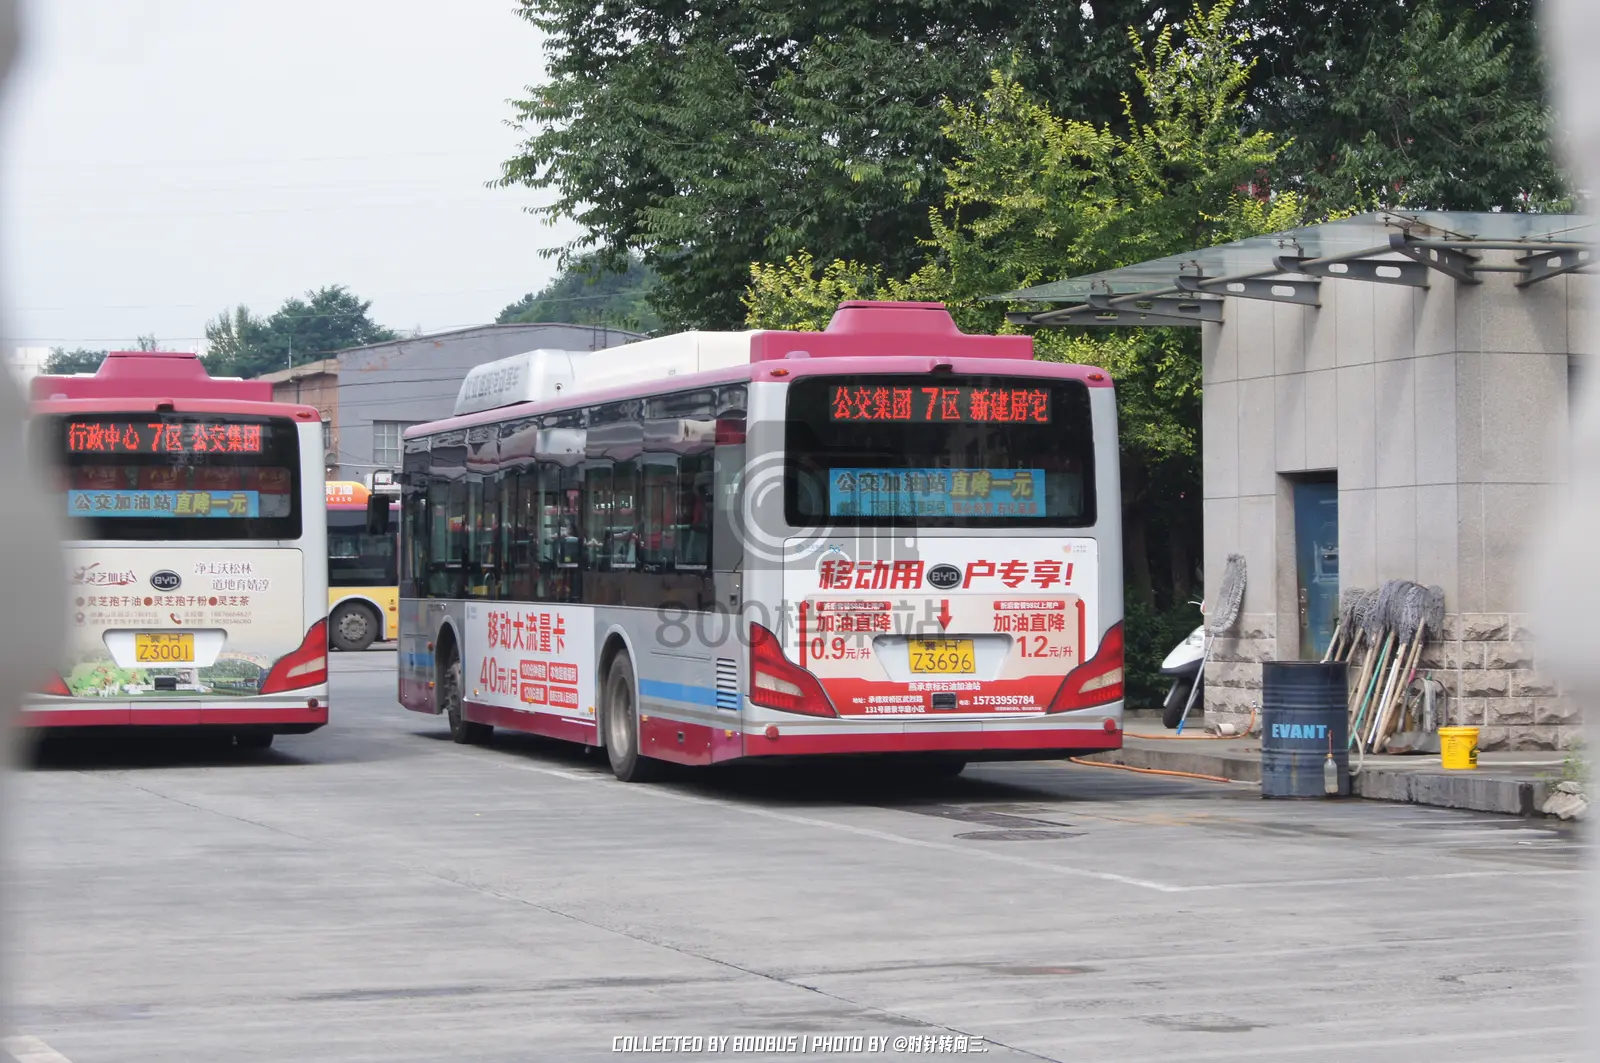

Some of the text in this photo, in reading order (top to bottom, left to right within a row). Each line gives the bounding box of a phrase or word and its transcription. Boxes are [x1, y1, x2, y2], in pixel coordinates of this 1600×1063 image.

[832, 386, 913, 420] 公交集团
[921, 387, 961, 420] 7区
[69, 423, 262, 452] 行政中心 7区 公交集团
[74, 492, 248, 515] 公交加油站直降一元
[154, 576, 177, 586] BYD
[818, 560, 925, 589] 移动用
[932, 571, 957, 582] BYD
[154, 595, 207, 607] 灵芝孢子粉
[217, 595, 249, 607] 灵芝茶
[815, 612, 892, 632] 加油直降
[993, 612, 1066, 632] 加油直降
[487, 610, 566, 654] 移动大流量卡
[139, 644, 189, 660] Z3001
[912, 653, 973, 671] Z3696
[973, 695, 1035, 705] 15733956784
[1272, 723, 1327, 739] EVANT
